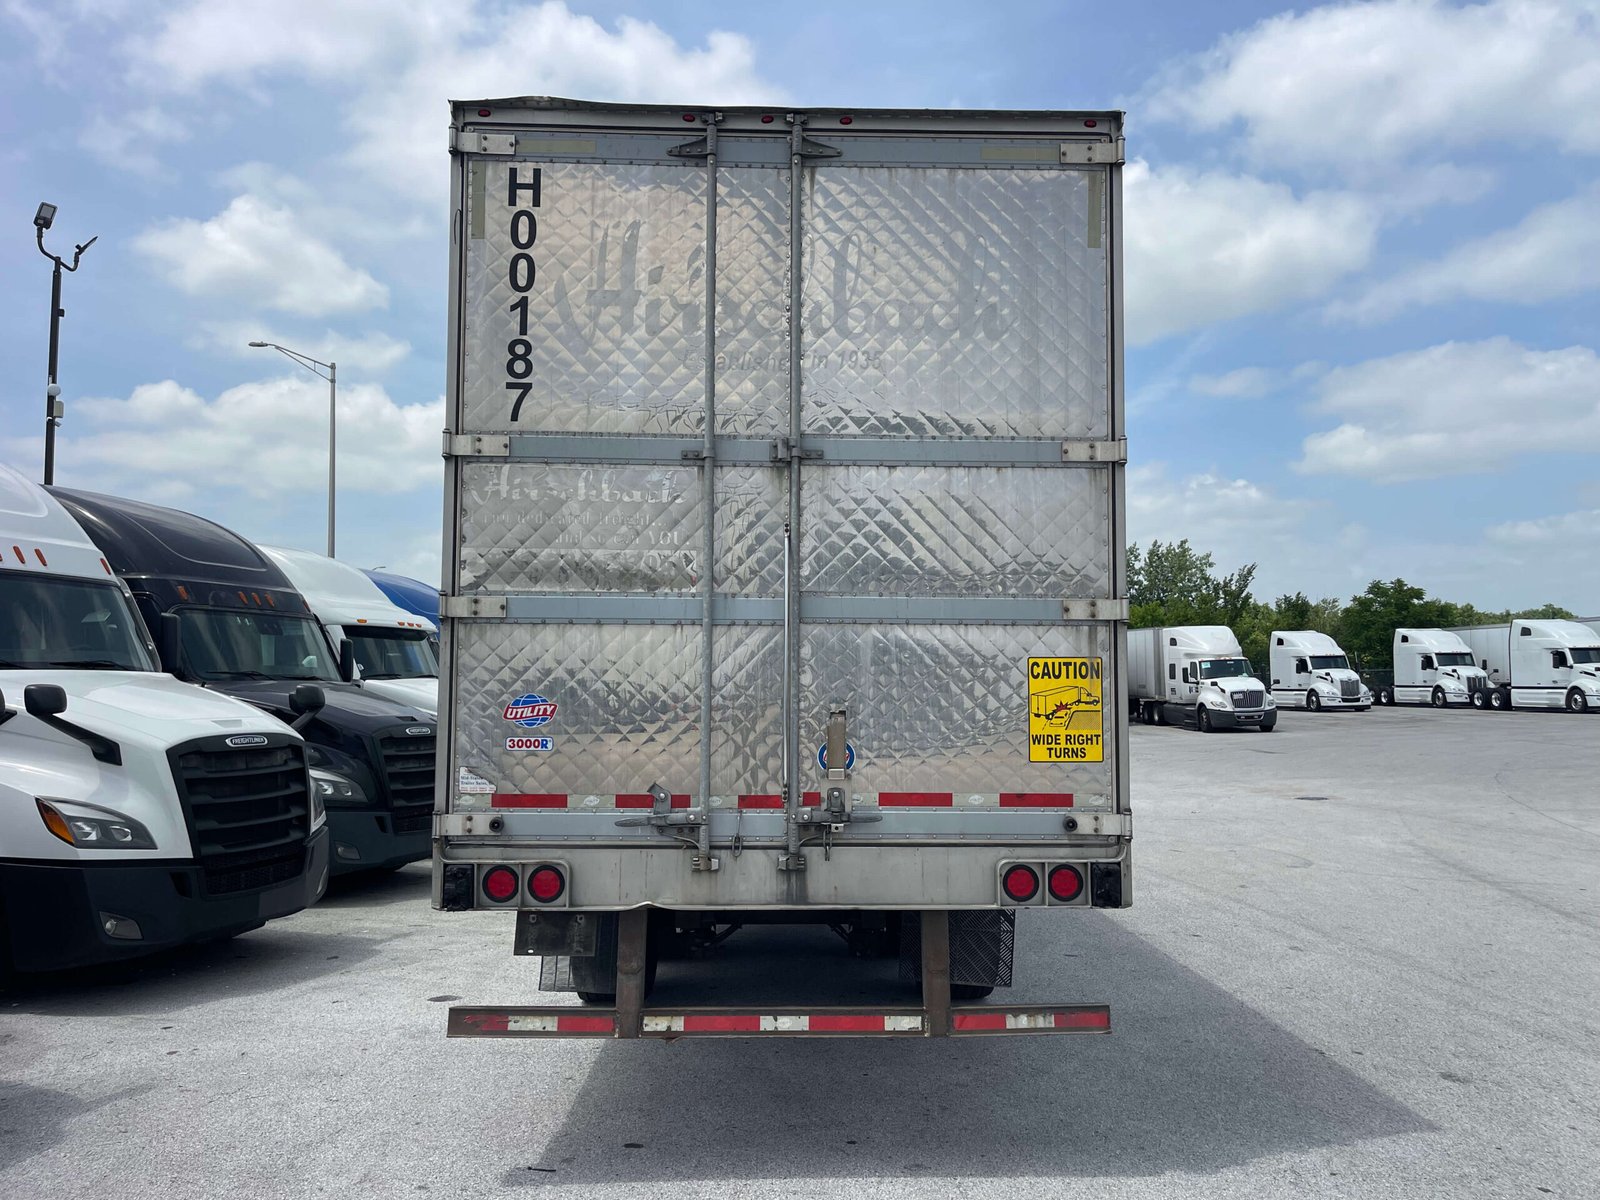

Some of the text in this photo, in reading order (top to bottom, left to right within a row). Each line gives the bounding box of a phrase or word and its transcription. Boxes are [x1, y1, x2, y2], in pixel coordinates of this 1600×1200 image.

[505, 167, 542, 422] H00187
[838, 350, 883, 370] 1935
[1030, 661, 1100, 679] CAUTION
[506, 705, 555, 719] UTILITY
[1031, 734, 1101, 745] WIDE RIGHT
[1047, 747, 1087, 758] TURNS
